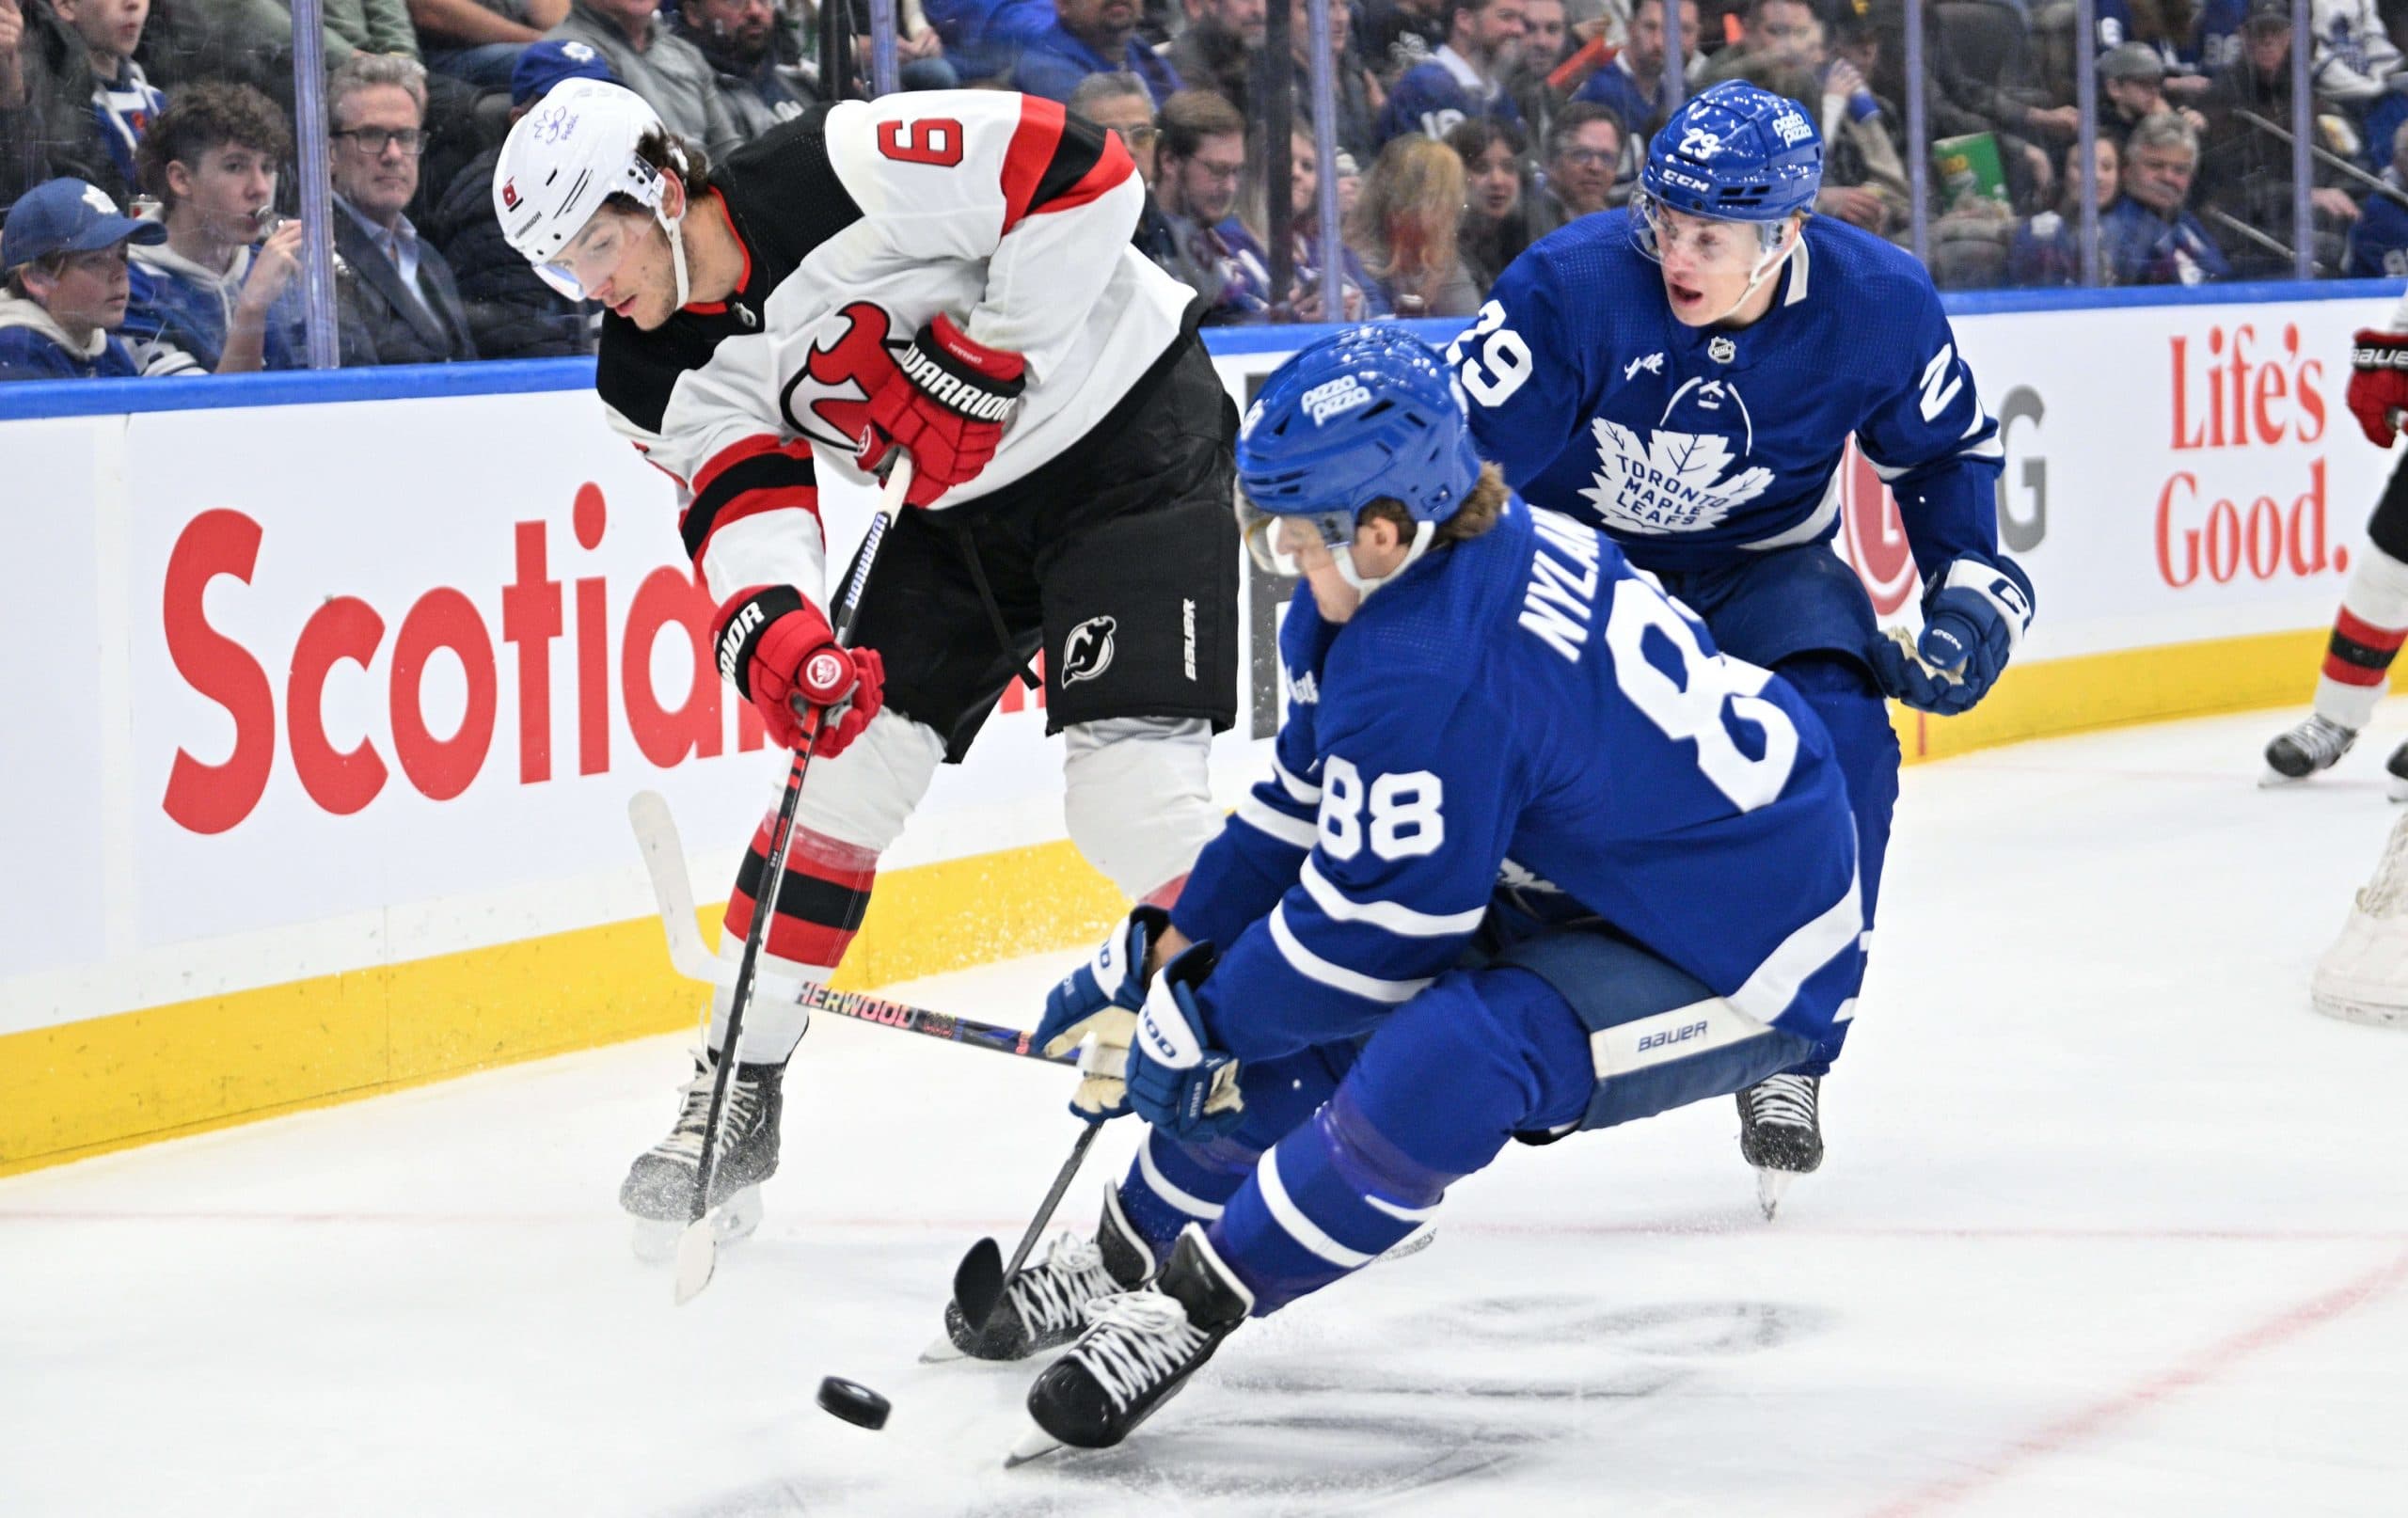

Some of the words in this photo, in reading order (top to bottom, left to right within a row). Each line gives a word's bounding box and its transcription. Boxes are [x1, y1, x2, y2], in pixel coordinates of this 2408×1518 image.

[878, 118, 964, 167] 6
[1679, 128, 1720, 159] 29
[1662, 169, 1710, 192] CCM
[901, 342, 1017, 421] WARRIOR
[1302, 374, 1357, 415] pizza
[1313, 387, 1371, 426] pizza
[2169, 323, 2326, 450] Life's
[1616, 454, 1731, 509] TORONTO
[1997, 385, 2047, 553] G
[1616, 493, 1698, 526] LEAFS
[1624, 478, 1703, 515] MAPLE
[2154, 454, 2349, 589] Good.
[845, 512, 888, 609] WARRIOR
[162, 481, 1046, 835] Scotia
[1318, 755, 1445, 861] 88
[797, 981, 918, 1030] HERWOOD
